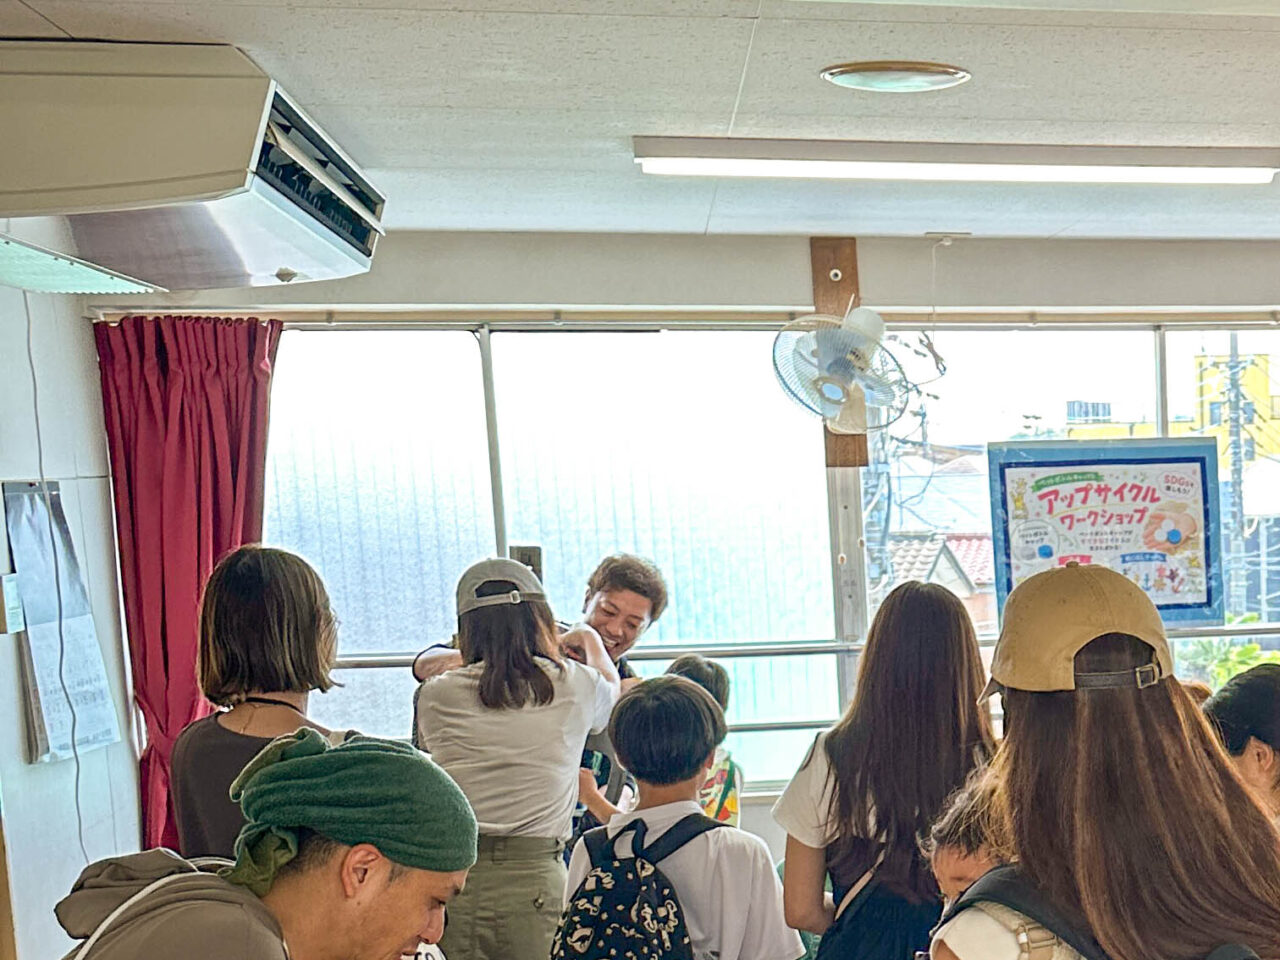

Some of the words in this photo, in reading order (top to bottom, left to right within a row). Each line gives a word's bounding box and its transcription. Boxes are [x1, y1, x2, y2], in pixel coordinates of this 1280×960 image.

[1037, 482, 1161, 515] アップサイクル
[1059, 506, 1149, 531] ワークショップ
